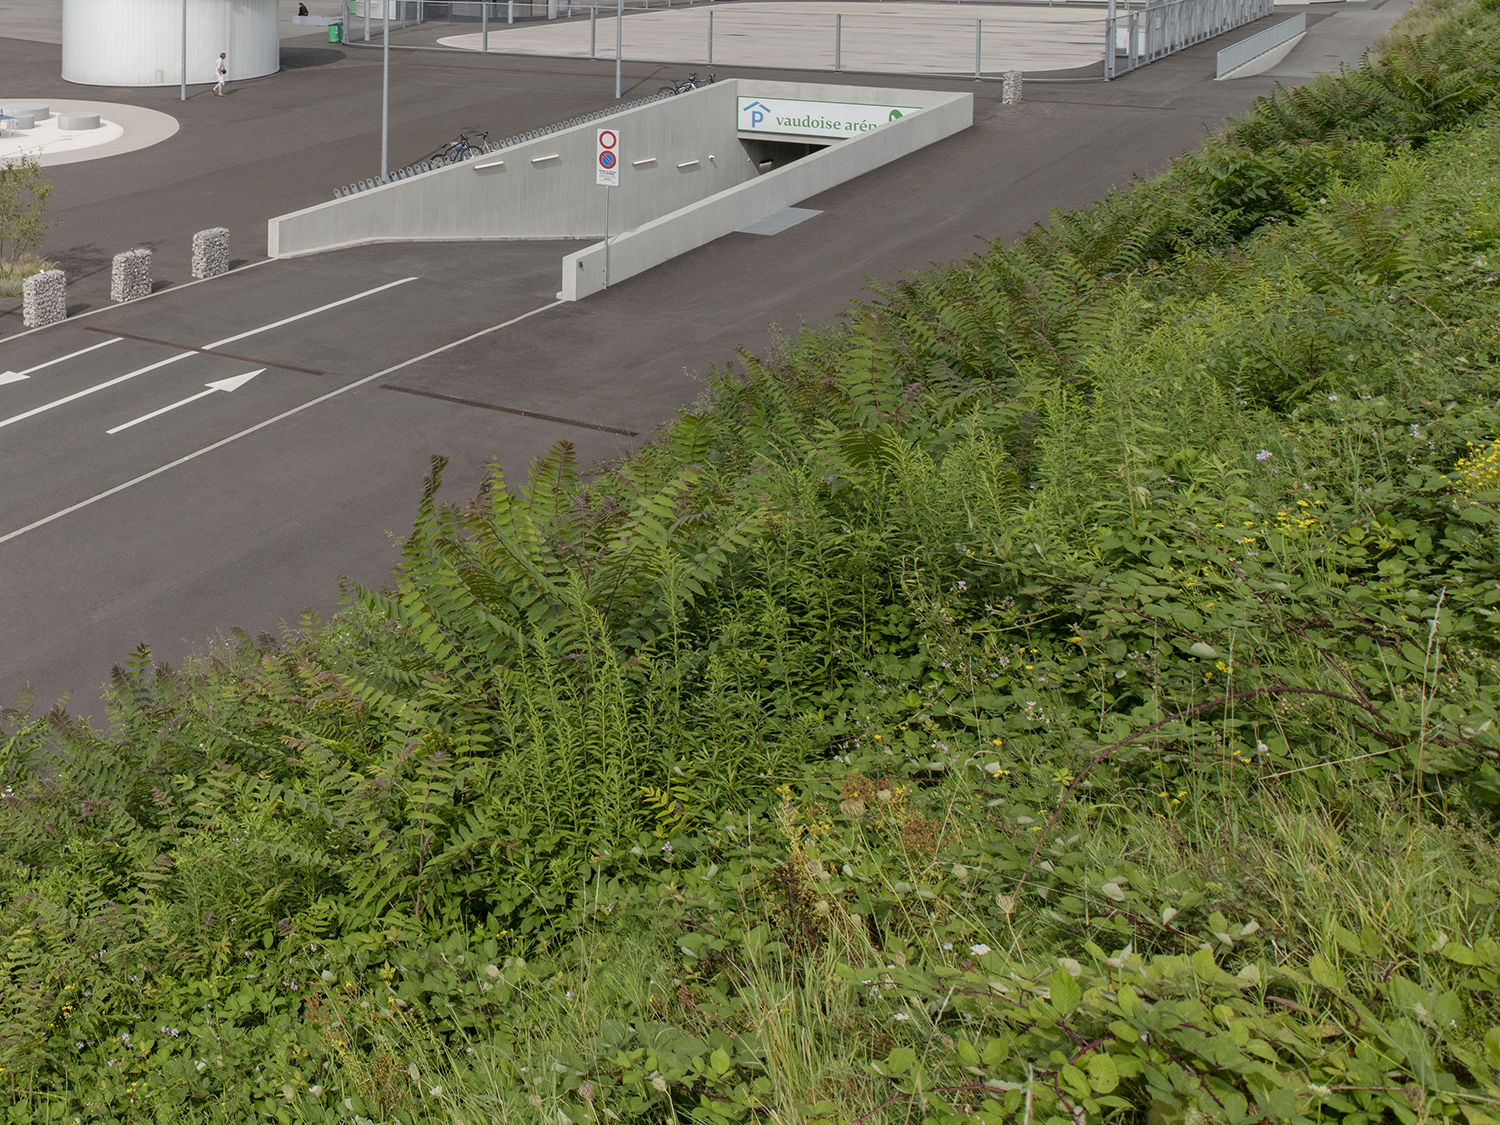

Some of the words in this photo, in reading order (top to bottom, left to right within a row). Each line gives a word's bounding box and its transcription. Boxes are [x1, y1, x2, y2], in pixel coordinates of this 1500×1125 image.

[751, 110, 764, 128] P
[776, 115, 842, 130] vaudoise
[844, 119, 883, 132] arén
